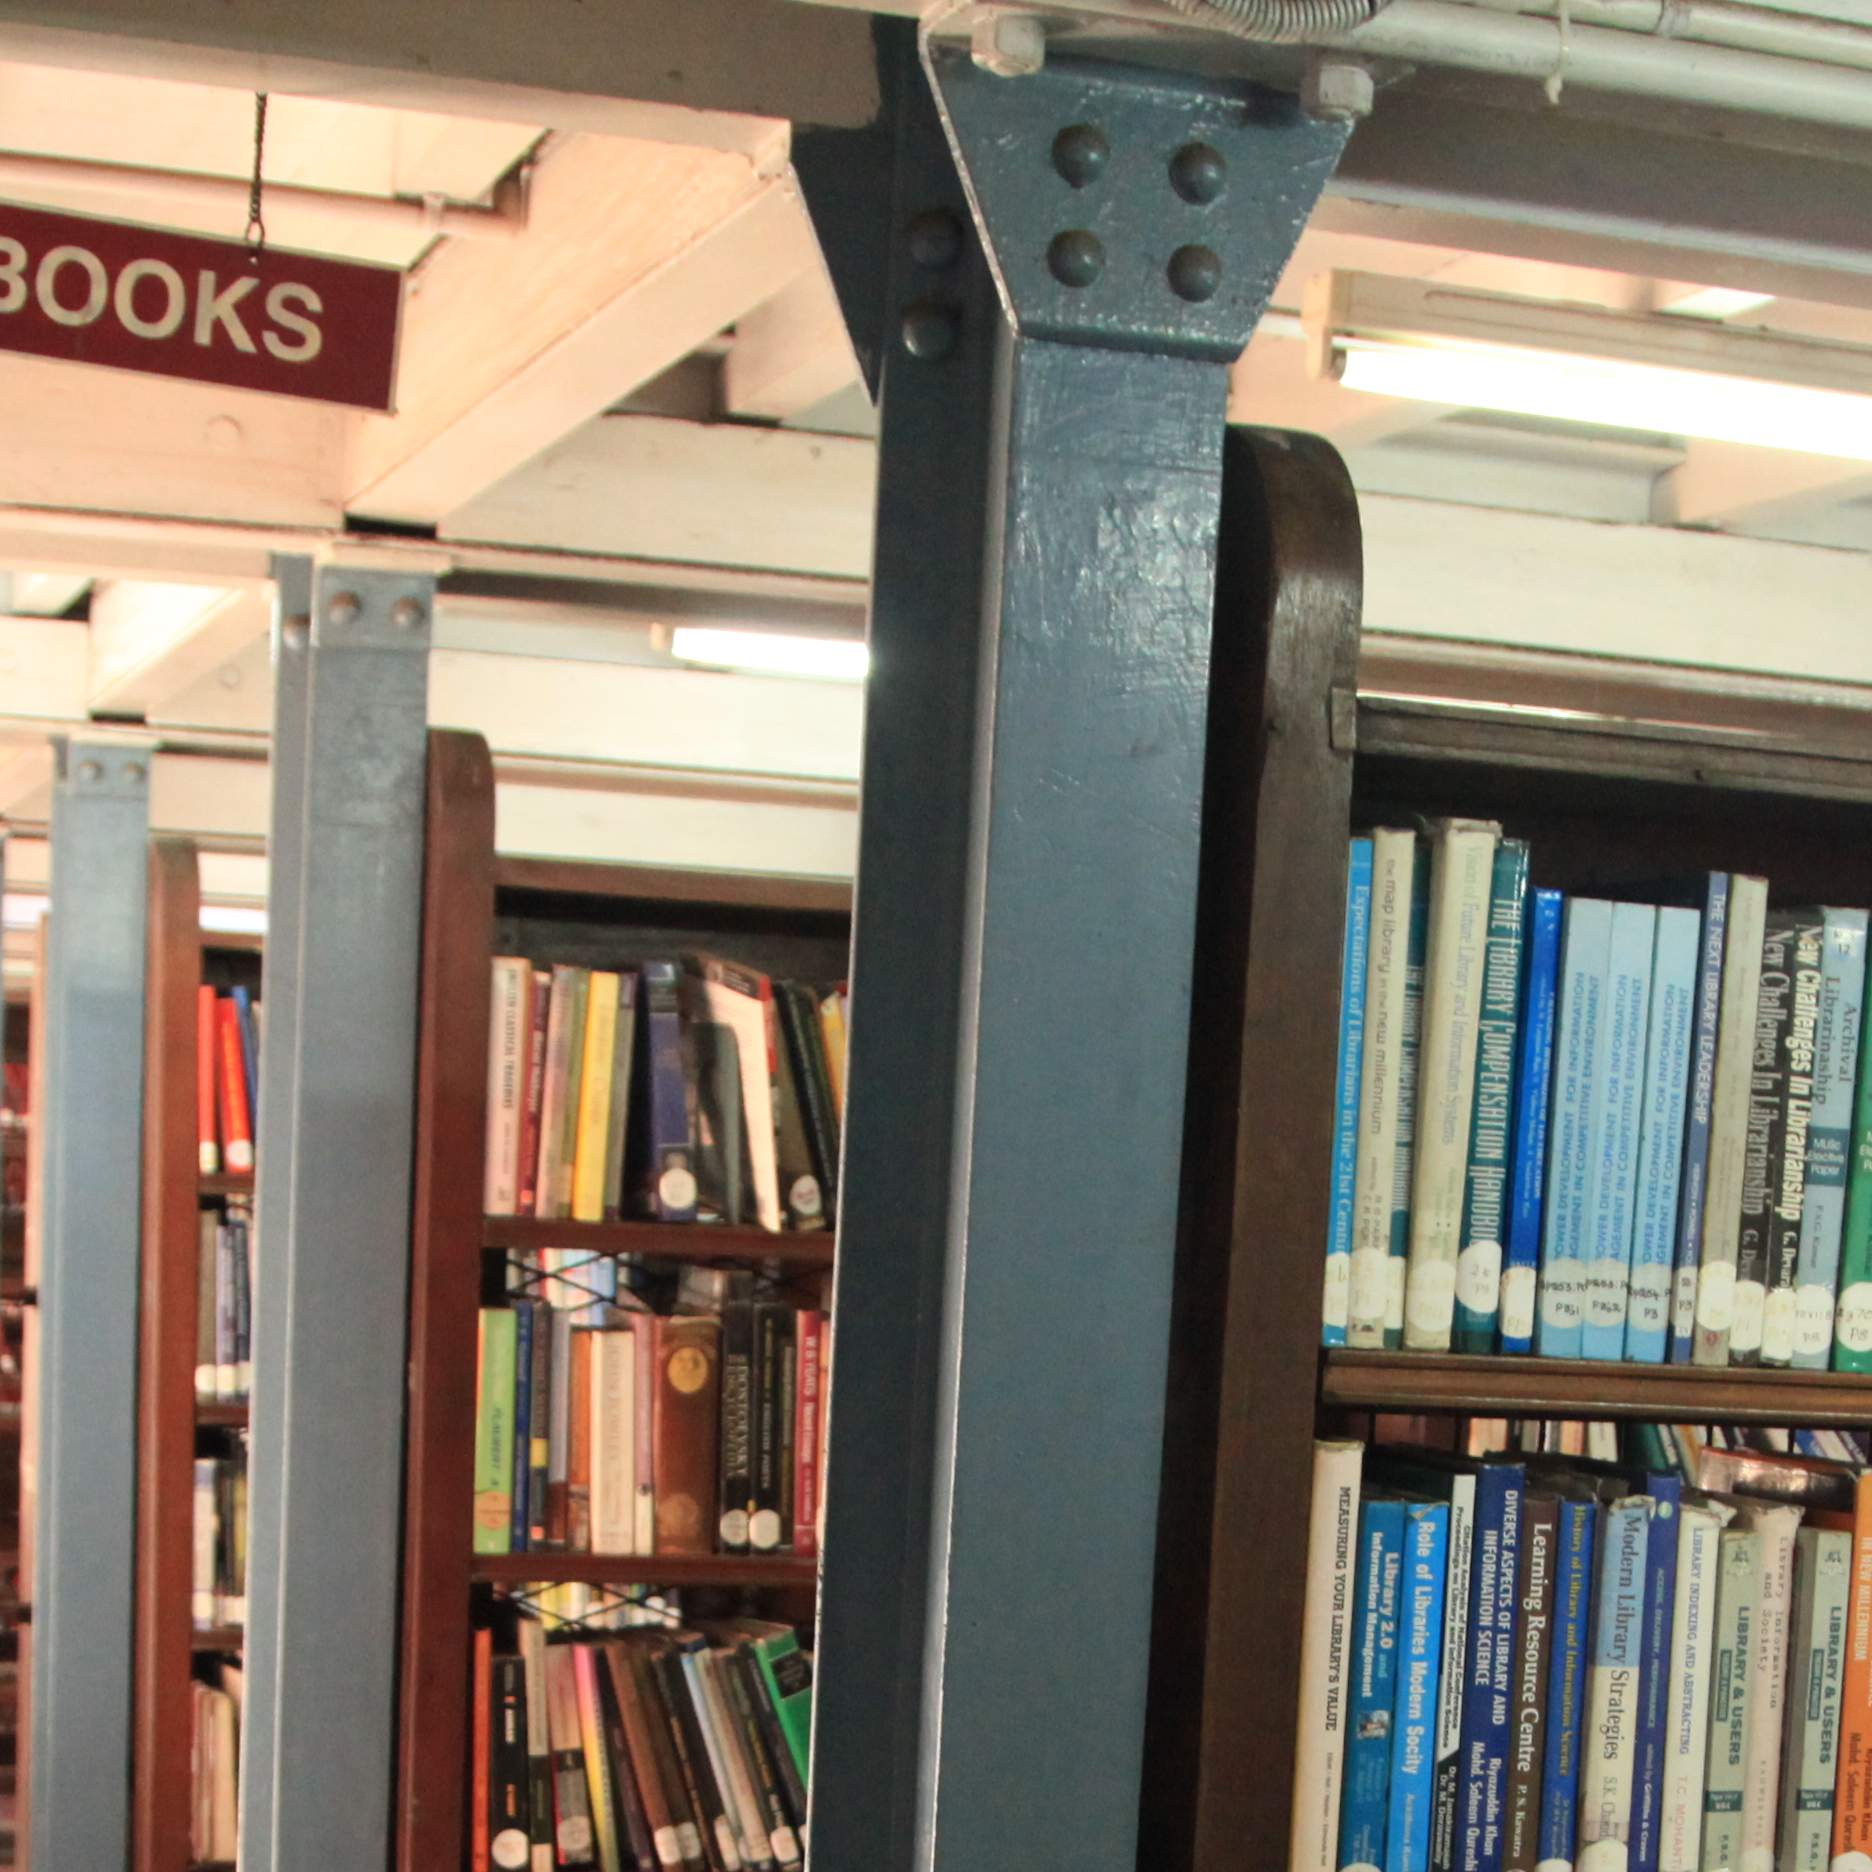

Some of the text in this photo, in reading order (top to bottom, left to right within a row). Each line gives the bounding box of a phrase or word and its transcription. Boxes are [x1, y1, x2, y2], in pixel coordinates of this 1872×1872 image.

[1785, 1075, 1815, 1095] In
[1787, 969, 1824, 1073] Challenges
[1837, 1000, 1859, 1084] Archival
[1469, 1164, 1505, 1246] HANDBO
[1775, 1097, 1813, 1221] Librarianship
[1324, 1485, 1352, 1733] MEASURING YOUR LIBRARY'S VALUE
[1361, 1531, 1384, 1699] Information Management
[1402, 1520, 1437, 1775] Role of Libraries Modern Socity
[1473, 1529, 1499, 1687] INFORMATION SCIENCE
[1491, 1489, 1519, 1726] DIVERSE ASPECTS OF LIBRARY AND
[1513, 1521, 1553, 1773] Learning Resource Centre
[1602, 1515, 1644, 1760] Modern Library Strategies
[1727, 1605, 1750, 1766] LIBRARY & USERS
